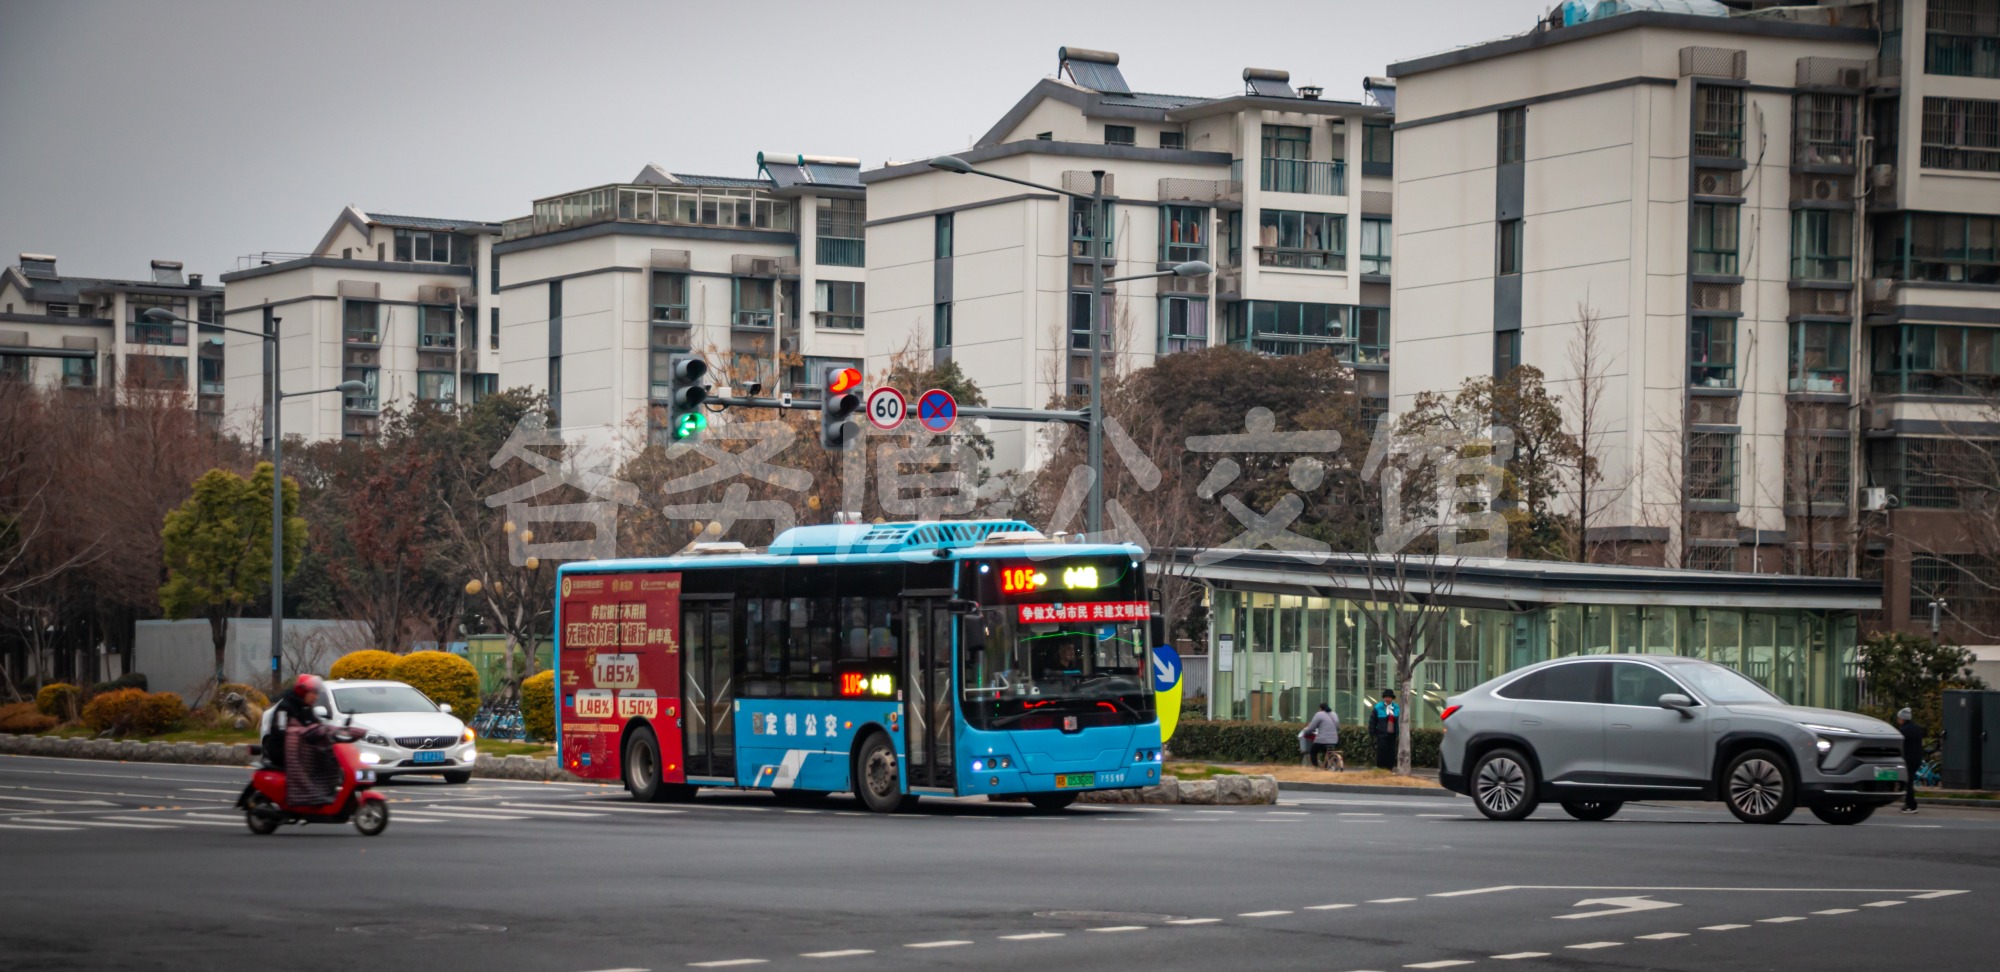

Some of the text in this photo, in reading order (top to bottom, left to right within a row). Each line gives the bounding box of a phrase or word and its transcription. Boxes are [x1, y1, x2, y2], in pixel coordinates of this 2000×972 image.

[875, 397, 898, 419] 60
[1002, 568, 1035, 591] 105
[1022, 605, 1088, 620] 争做文明市民
[566, 622, 672, 646] 无锡农村商业银行 利率高
[597, 664, 635, 682] 1.85%
[844, 674, 862, 694] 105
[579, 699, 654, 715] 1.48% 1.50%
[765, 712, 838, 738] 定制公交
